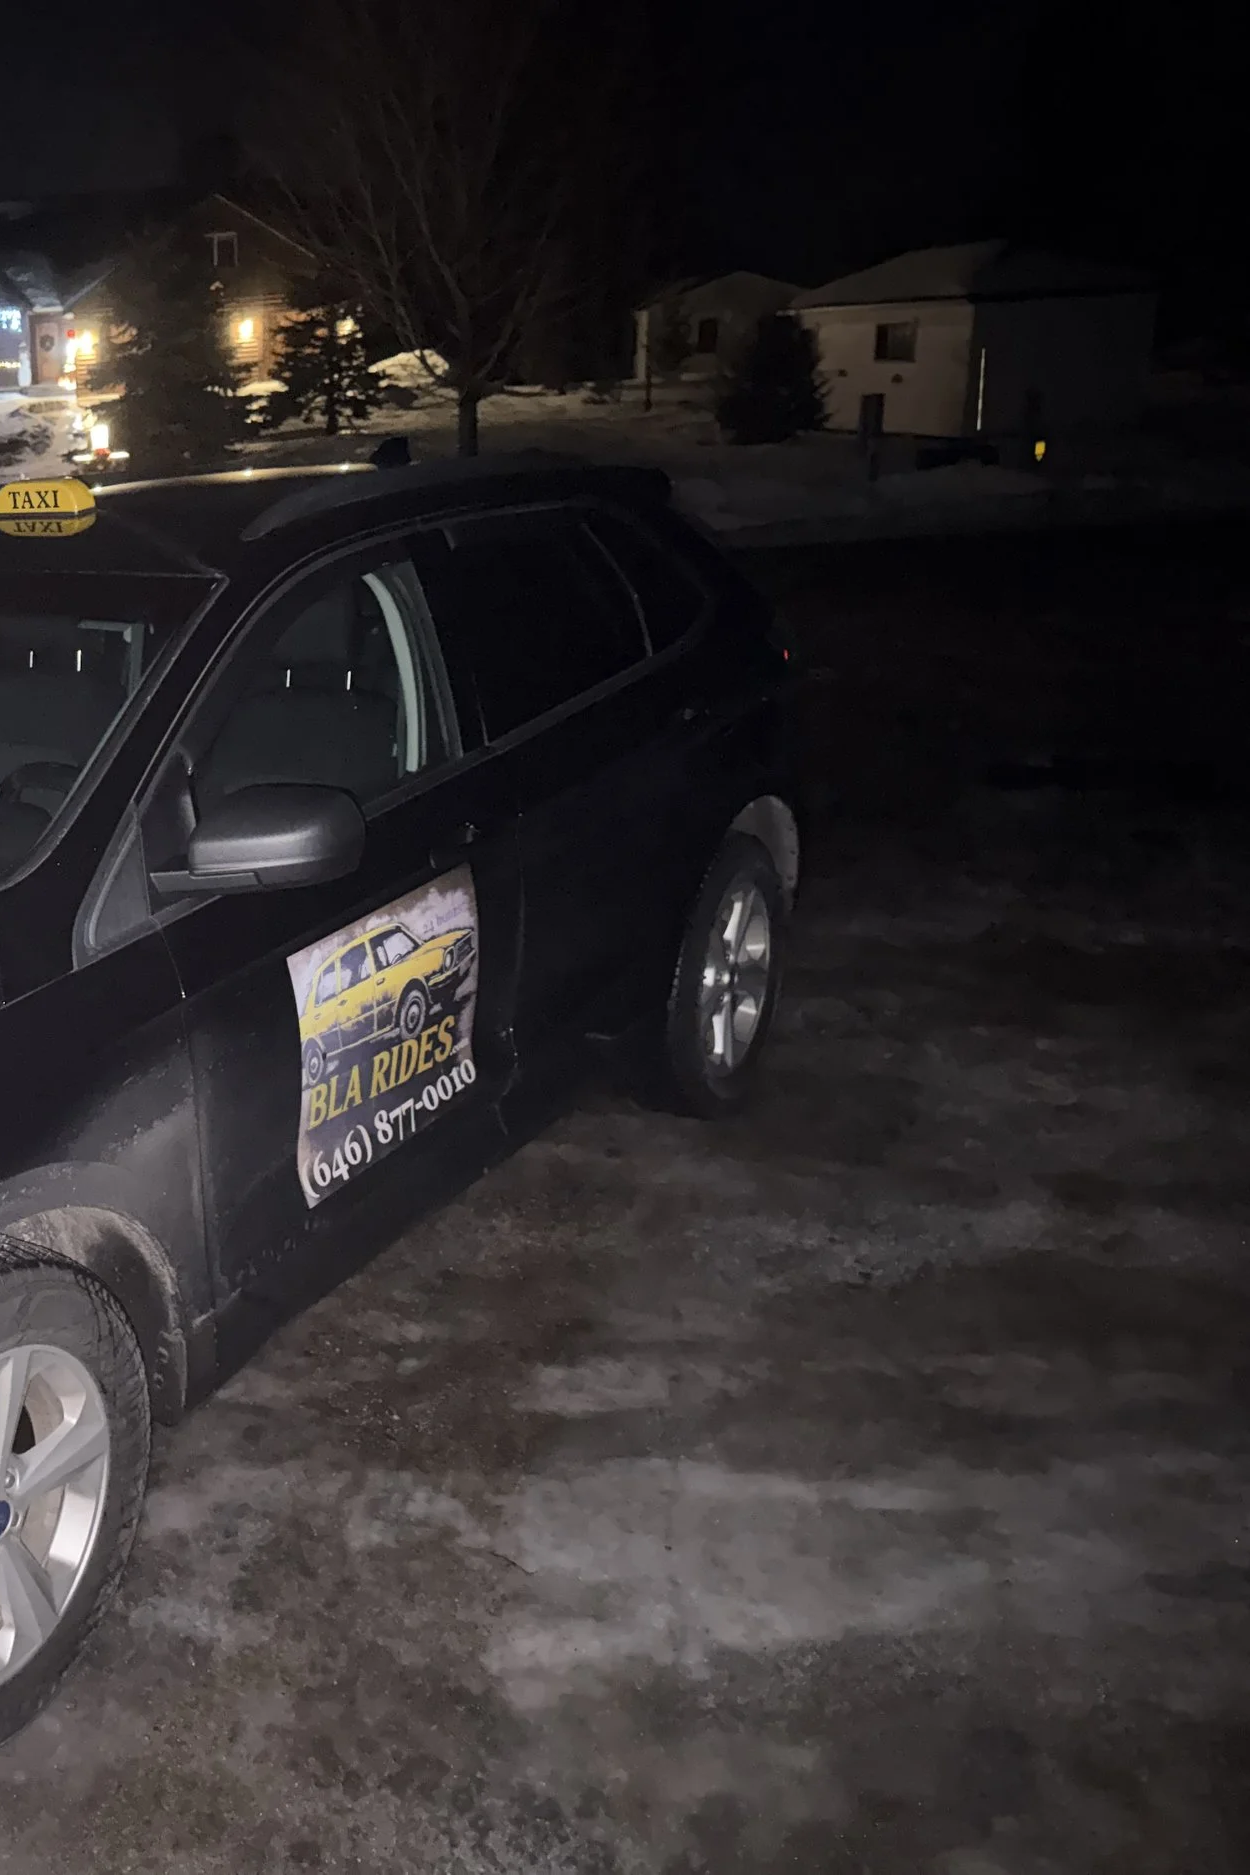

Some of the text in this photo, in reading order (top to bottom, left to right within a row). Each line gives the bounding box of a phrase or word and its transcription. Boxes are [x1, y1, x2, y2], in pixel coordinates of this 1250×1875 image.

[8, 490, 60, 509] TAXI
[302, 1058, 477, 1198] (646) 877-0010
[307, 1064, 363, 1131] BLA
[369, 1015, 455, 1099] RIDES
